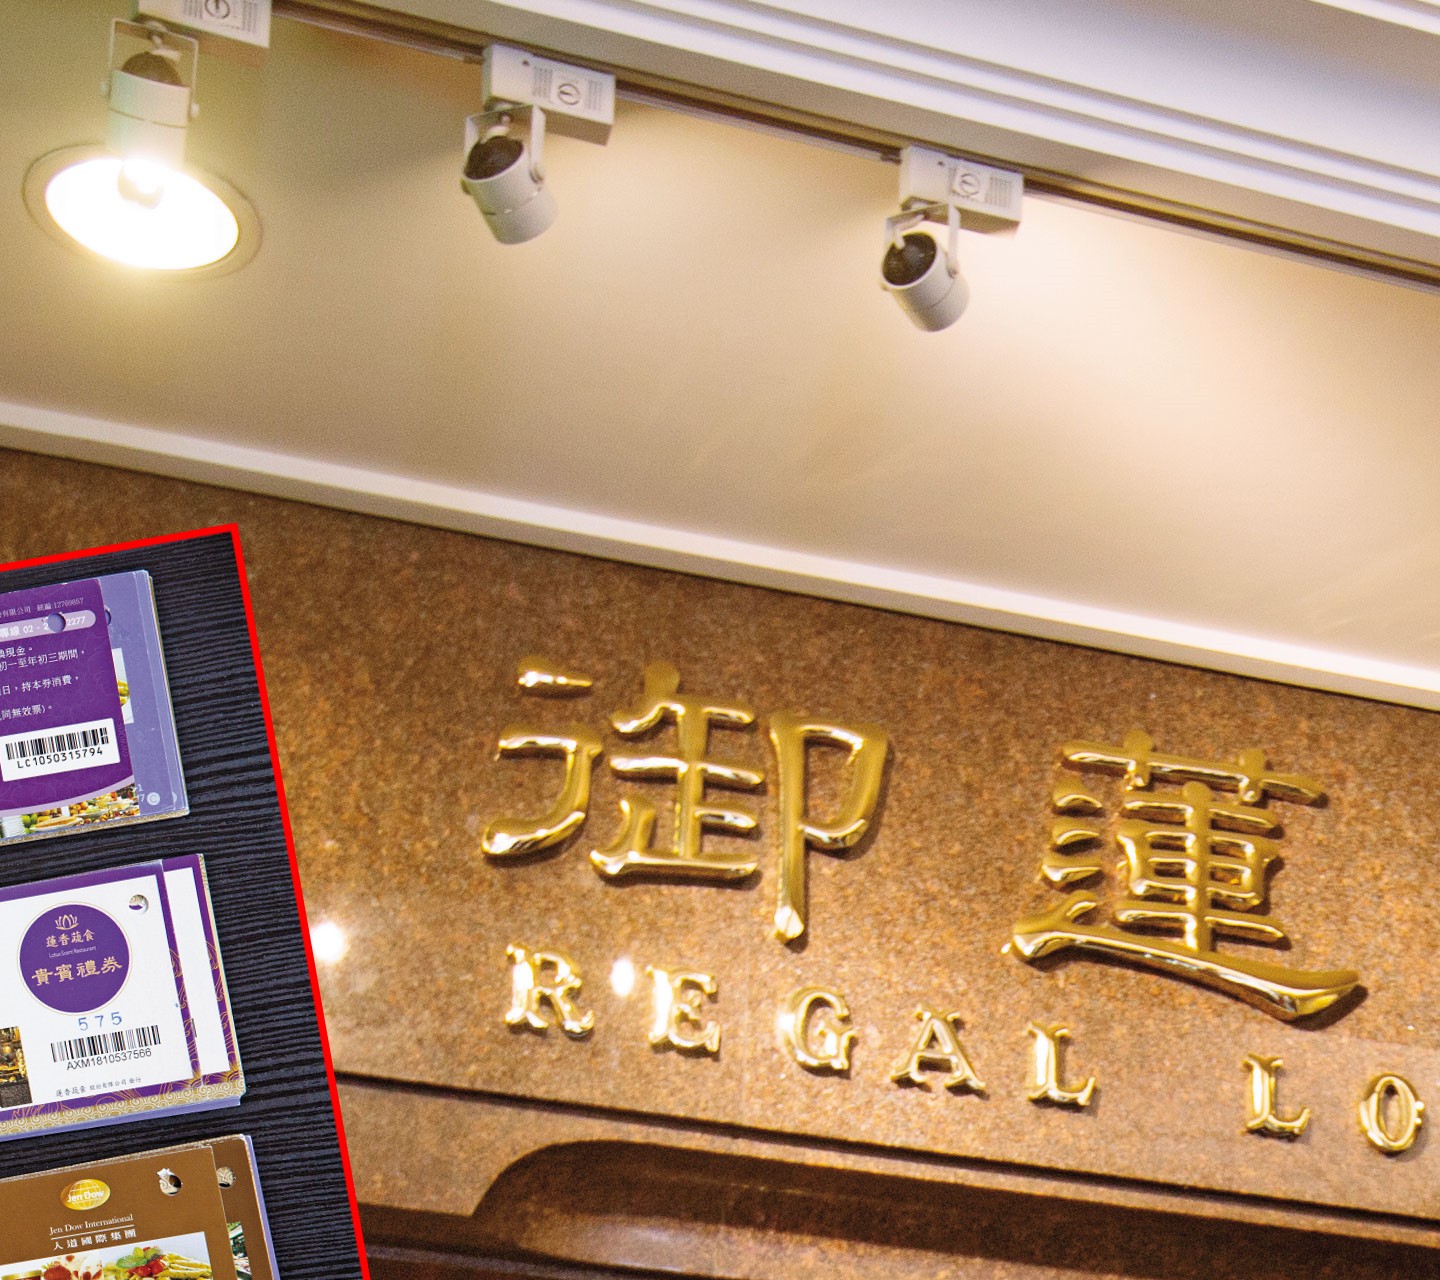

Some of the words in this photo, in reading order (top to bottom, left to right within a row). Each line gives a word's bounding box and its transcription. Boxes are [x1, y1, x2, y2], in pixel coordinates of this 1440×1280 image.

[22, 625, 34, 634] 02
[16, 746, 104, 769] LC1050315794
[44, 927, 96, 949] 蓮香蔬食
[30, 954, 123, 987] 貴賓禮券
[503, 942, 1100, 1108] REGAL
[65, 1047, 152, 1071] AXM1810537566
[66, 1191, 84, 1204] Jen
[83, 1188, 106, 1200] Dow
[47, 1224, 64, 1236] Jen
[63, 1221, 84, 1232] Dow
[83, 1213, 134, 1229] International
[52, 1227, 137, 1251] 人道國際集團
